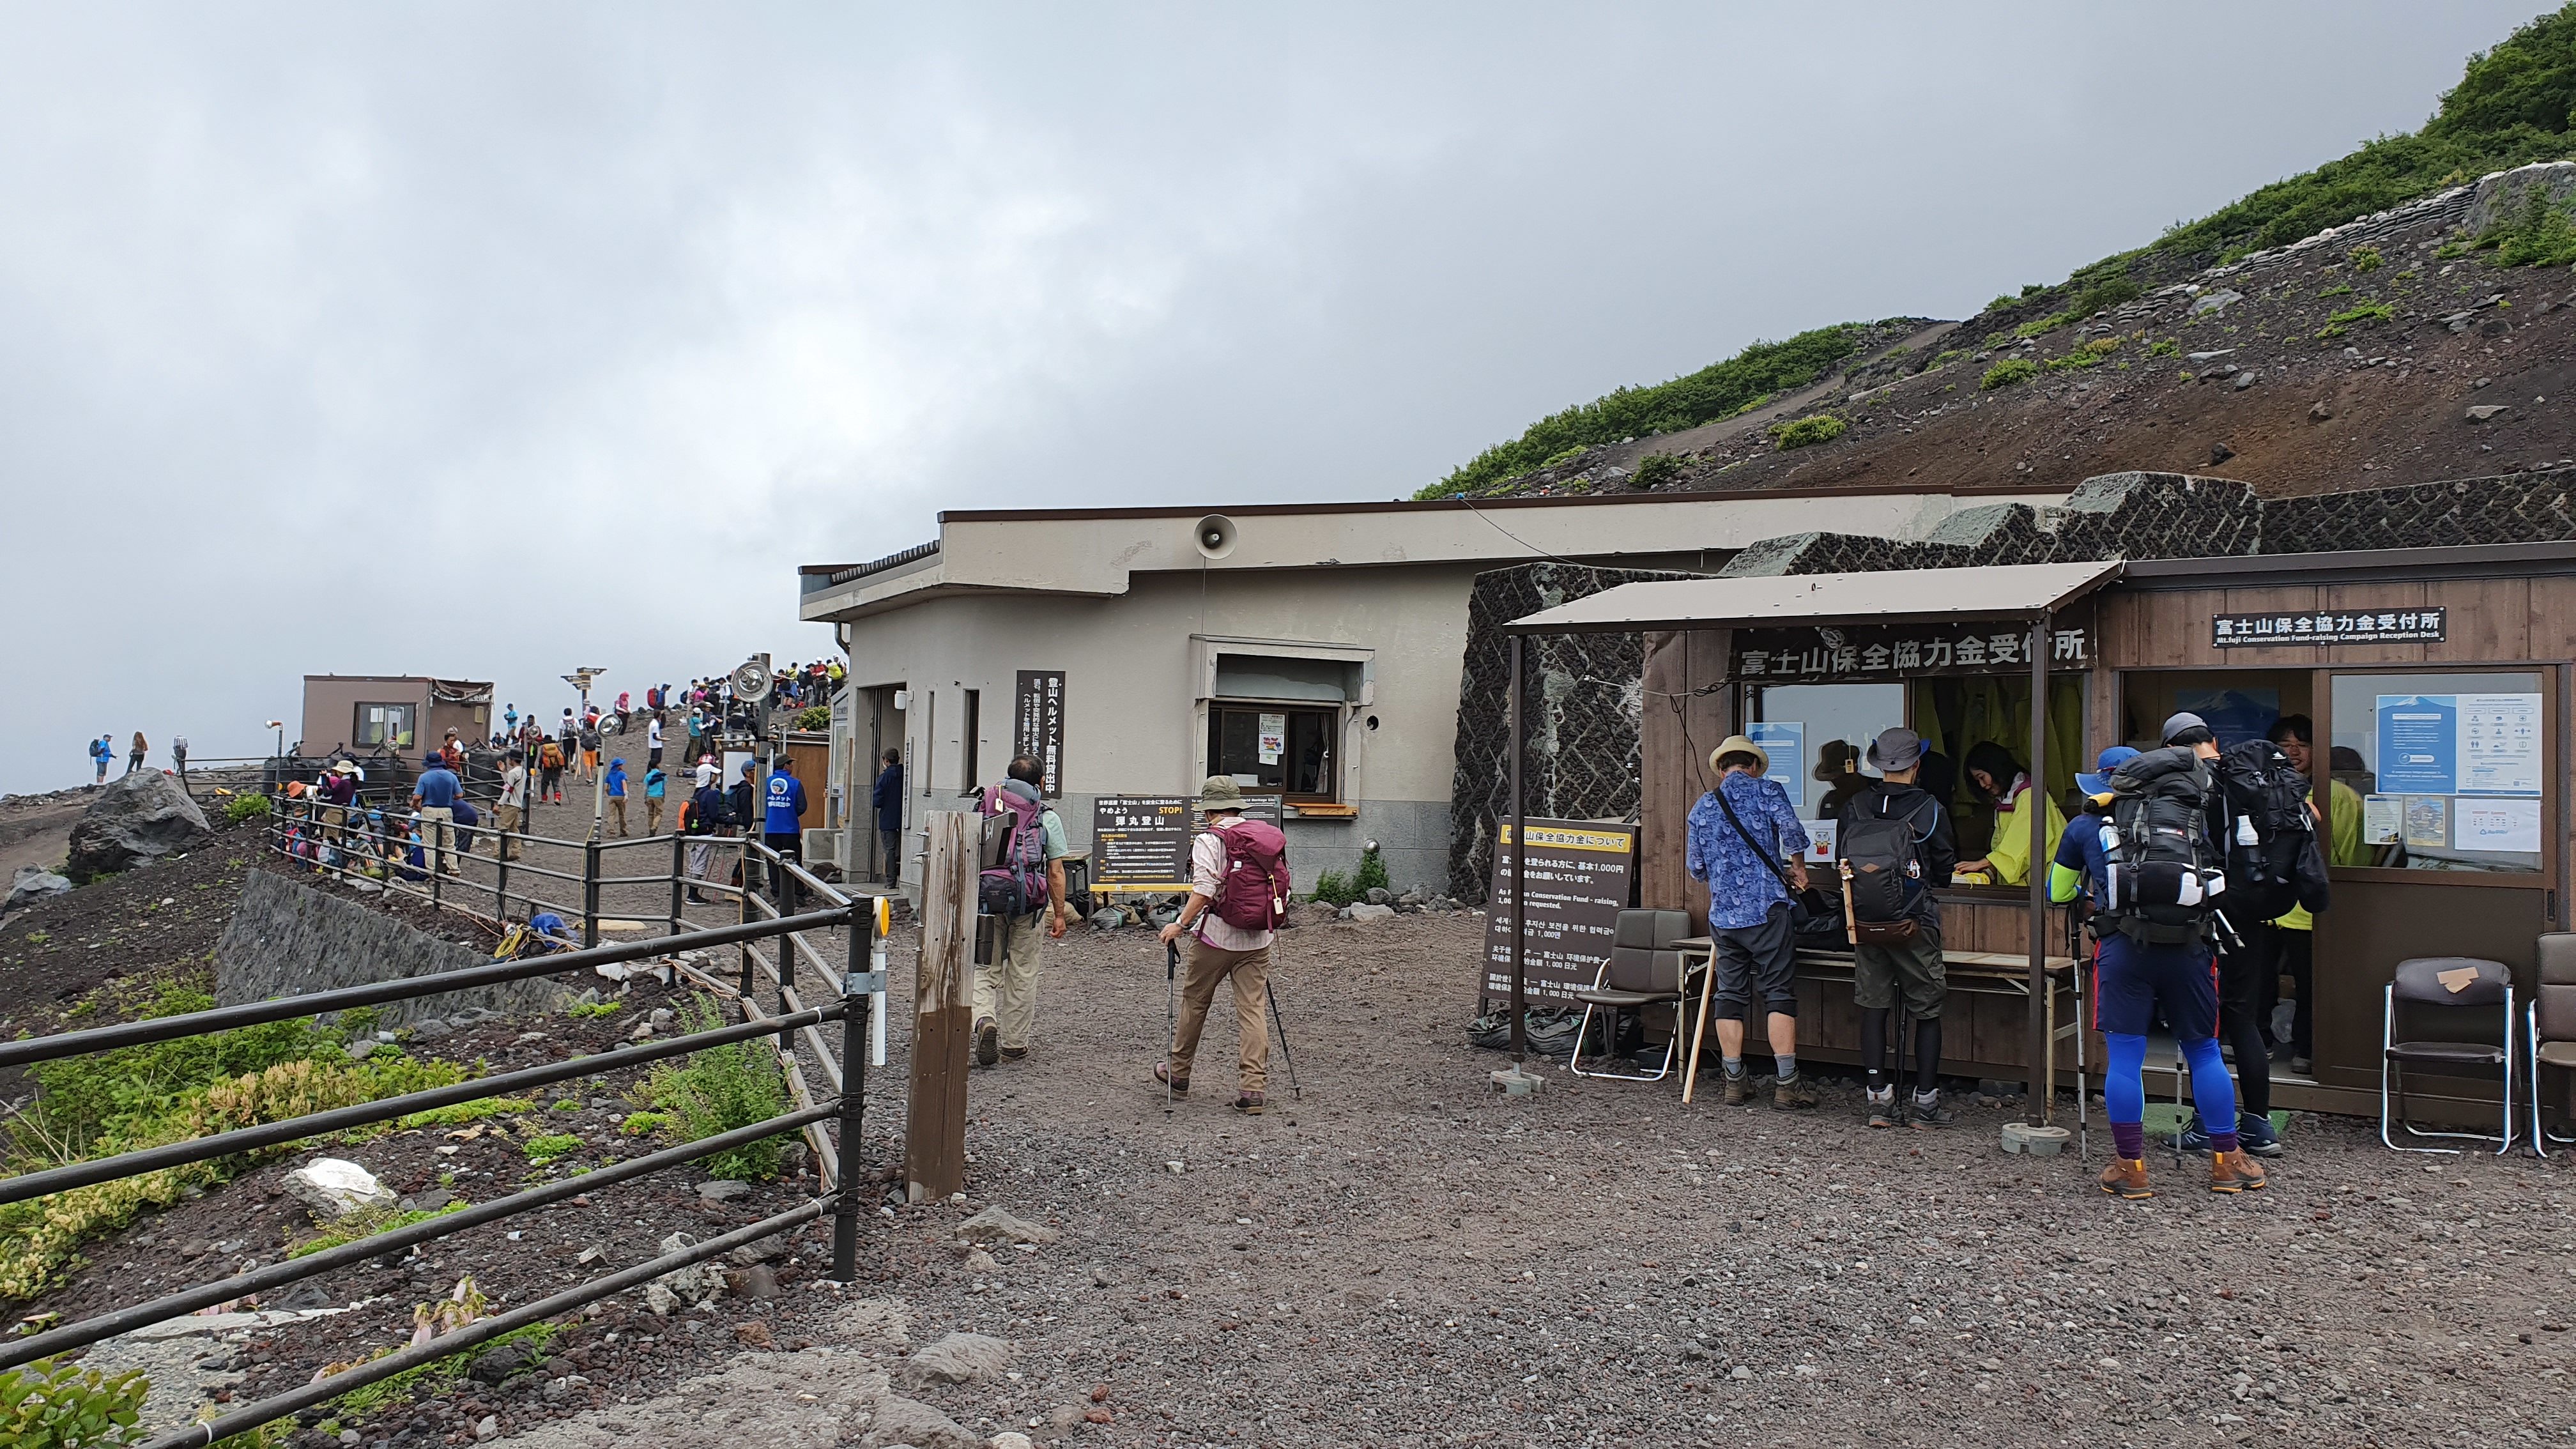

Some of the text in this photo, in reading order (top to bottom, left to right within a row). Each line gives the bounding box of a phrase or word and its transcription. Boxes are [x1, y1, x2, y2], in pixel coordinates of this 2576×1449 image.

[2216, 612, 2441, 635] 富士山保全協力金受付所
[2243, 634, 2290, 643] Conservation
[2291, 633, 2338, 642] Fund-raising
[2340, 632, 2378, 641] Campaign
[2380, 631, 2419, 640] Reception
[2420, 630, 2440, 638] Desk
[1045, 677, 1058, 793] 登山ヘルメット無料貸出中
[1116, 816, 1165, 826] 弾丸登山
[1507, 829, 1625, 847] 山保全協力金について
[1500, 868, 1594, 885] の金をお願いしています。
[1531, 891, 1572, 902] Conservation
[1529, 901, 1561, 909] requested.
[1524, 919, 1545, 928] 후지산
[1572, 924, 1586, 933] 위한
[1543, 951, 1563, 960] 富士山
[1564, 962, 1577, 970] 日元
[1540, 979, 1560, 989] 富士山
[1561, 990, 1574, 999] 日元
